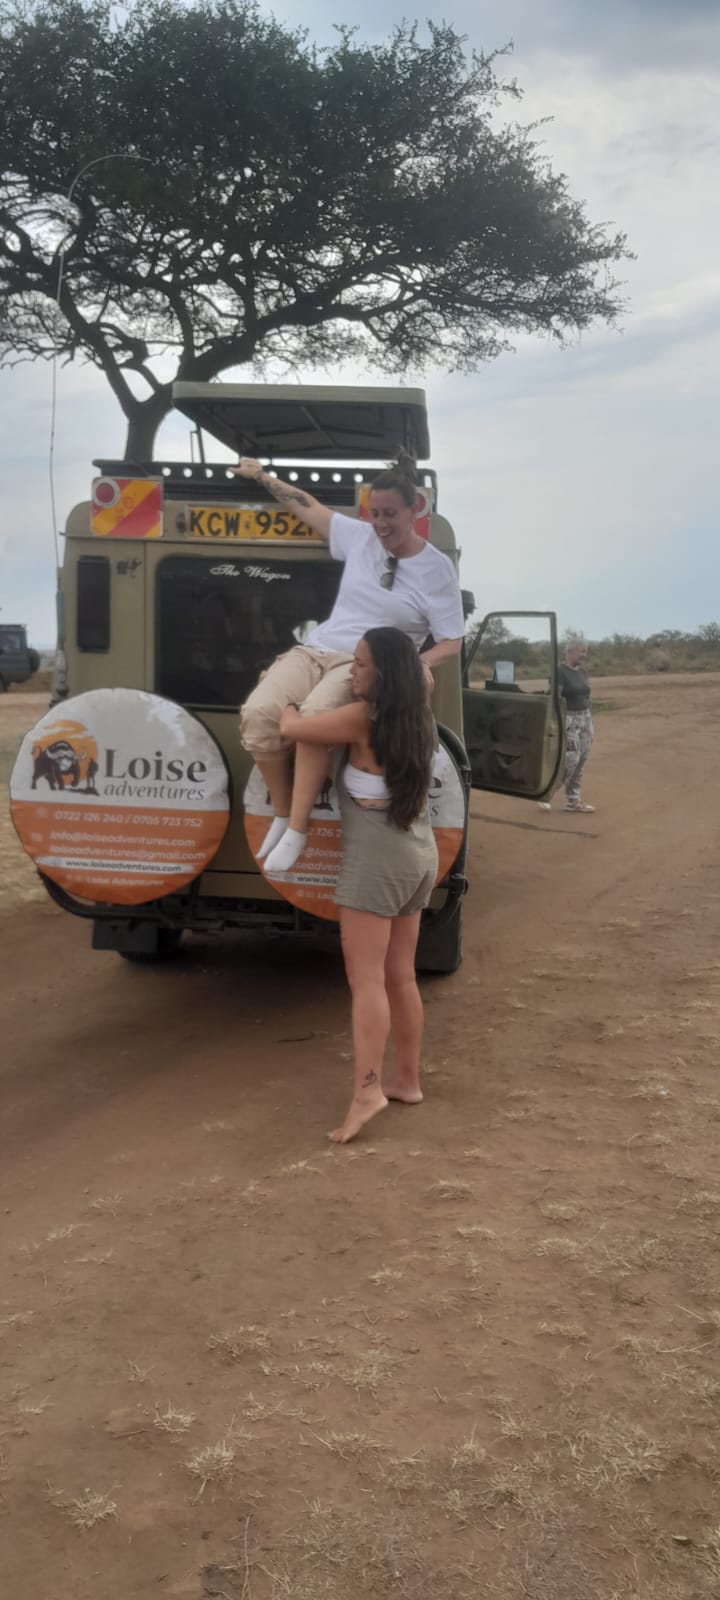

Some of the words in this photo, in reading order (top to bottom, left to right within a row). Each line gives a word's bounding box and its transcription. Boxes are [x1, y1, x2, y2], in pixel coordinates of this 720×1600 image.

[190, 509, 240, 537] KCW
[255, 511, 314, 537] 952
[209, 563, 240, 577] The
[244, 565, 291, 582] Wagon
[104, 747, 208, 783] Loise
[103, 781, 207, 801] adventures
[54, 810, 81, 821] 0722
[103, 813, 124, 824] 240
[50, 830, 196, 847] info@loiseadventures.com
[65, 859, 182, 873] www.loiseadventures.com
